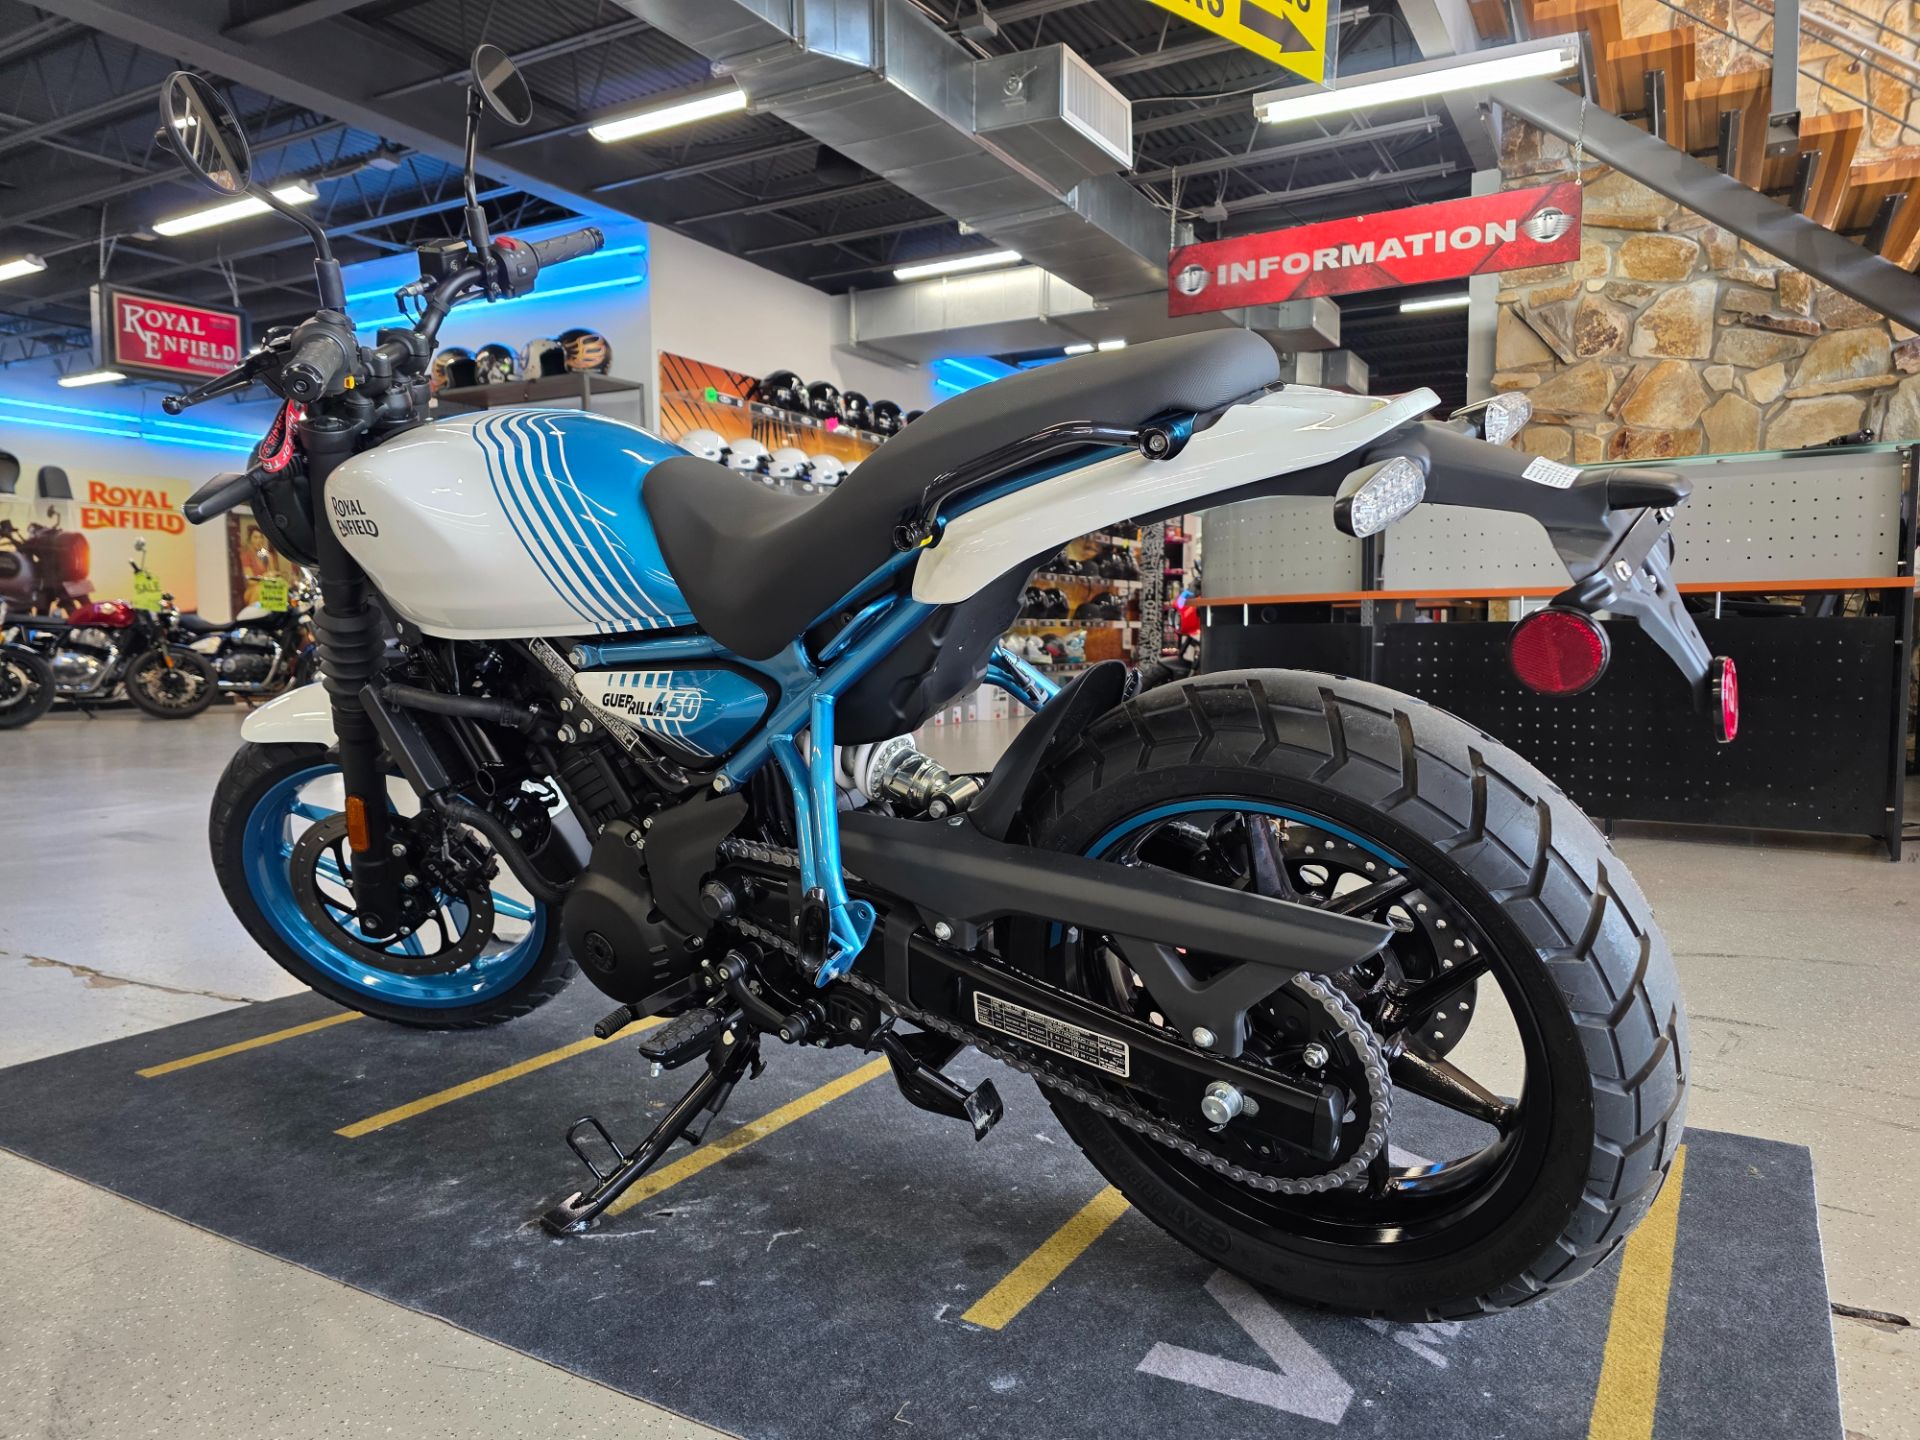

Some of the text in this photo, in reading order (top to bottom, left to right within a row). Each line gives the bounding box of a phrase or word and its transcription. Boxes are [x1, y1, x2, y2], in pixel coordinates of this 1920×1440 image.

[1216, 219, 1517, 286] INFORMATION
[122, 304, 206, 341] ROYAL
[143, 329, 236, 361] ENFIELD
[87, 480, 173, 509] ROYAL
[331, 496, 366, 516] ROYAL
[80, 506, 186, 535] ENFIELD
[336, 519, 379, 537] ENFIELD
[602, 691, 700, 720] GUERRILLA 450
